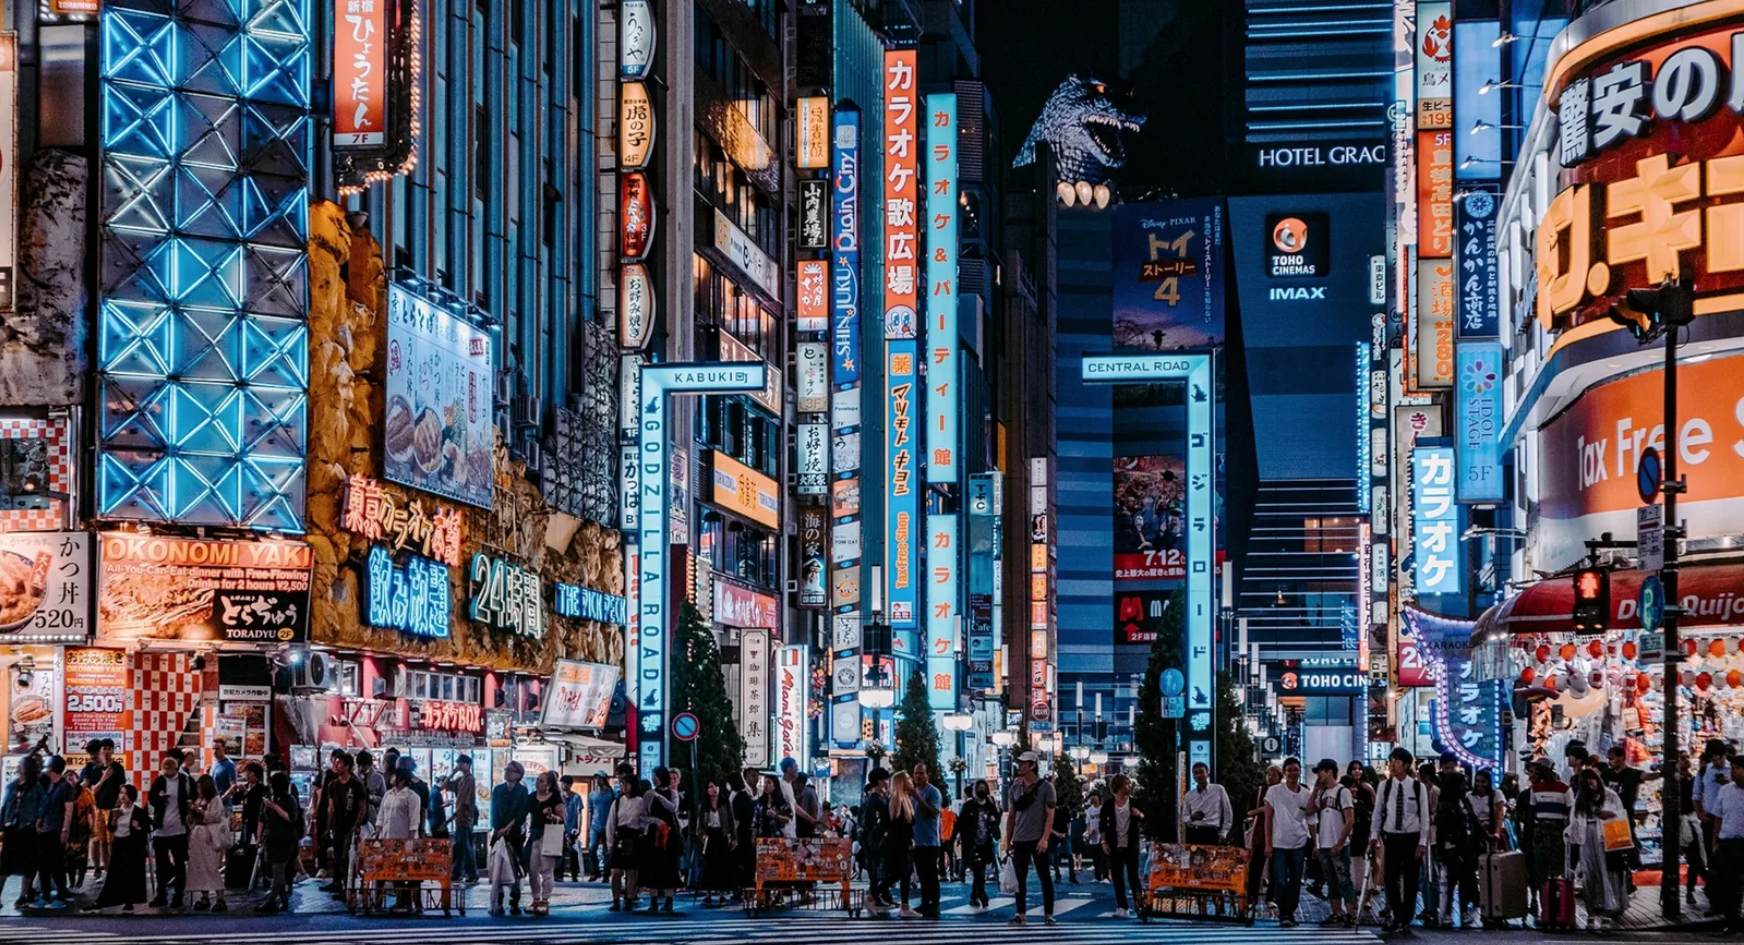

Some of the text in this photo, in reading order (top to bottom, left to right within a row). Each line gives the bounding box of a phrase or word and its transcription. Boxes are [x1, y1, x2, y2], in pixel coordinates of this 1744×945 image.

[345, 15, 373, 128] ひょうたん
[627, 65, 639, 74] 5F
[352, 134, 369, 144] 7F
[625, 105, 648, 146] 虎の子
[624, 154, 639, 163] 4F
[1259, 148, 1325, 167] HOTEL
[887, 60, 915, 296] カラオケ歌広場
[803, 183, 822, 238] 山内農場
[1140, 216, 1196, 229] Disney PIXAR
[1149, 229, 1196, 260] トイ
[1143, 262, 1196, 276] ストーリー
[1272, 255, 1304, 266] TOHO
[1272, 265, 1316, 276] CINEMAS
[1463, 221, 1484, 329] かんかん商店
[932, 110, 952, 466] カラオケ&パーティー館
[1154, 276, 1180, 306] 4
[1269, 287, 1326, 300] IMAX
[628, 278, 642, 339] お好み焼き
[805, 319, 820, 329] 4F
[892, 355, 911, 374] 薬
[1088, 361, 1190, 373] CENTRAL ROAD
[805, 398, 822, 409] 3F
[1468, 399, 1481, 449] STAGE
[1480, 399, 1494, 439] IDOL
[892, 382, 912, 497] マツモトキヨシ
[1468, 465, 1493, 481] 5F
[1577, 435, 1608, 491] Tax
[805, 513, 821, 556] 海の家
[896, 511, 909, 541] Shop
[1421, 454, 1454, 586] カラオケ
[106, 538, 312, 568] OKONOMI YAKI
[643, 421, 661, 681] GODZILLA ROAD
[1143, 549, 1180, 566] 7.12
[1191, 432, 1209, 659] ゴジラロード
[59, 537, 80, 605] かつ丼
[187, 579, 308, 593] Drinks for 2 hours ¥2,500
[223, 568, 244, 578] with
[246, 569, 309, 582] Free-Flowing
[369, 547, 449, 638] 飲み放題
[470, 551, 541, 639] 24時間
[558, 583, 580, 616] THE
[35, 609, 84, 629] 520円
[934, 532, 951, 690] カラオケ館
[226, 628, 292, 639] TORADYU 2F
[971, 622, 991, 632] Cafe
[1301, 675, 1341, 688] TOHO
[67, 695, 123, 713] 2,500円
[424, 701, 481, 732] カラオケBOX
